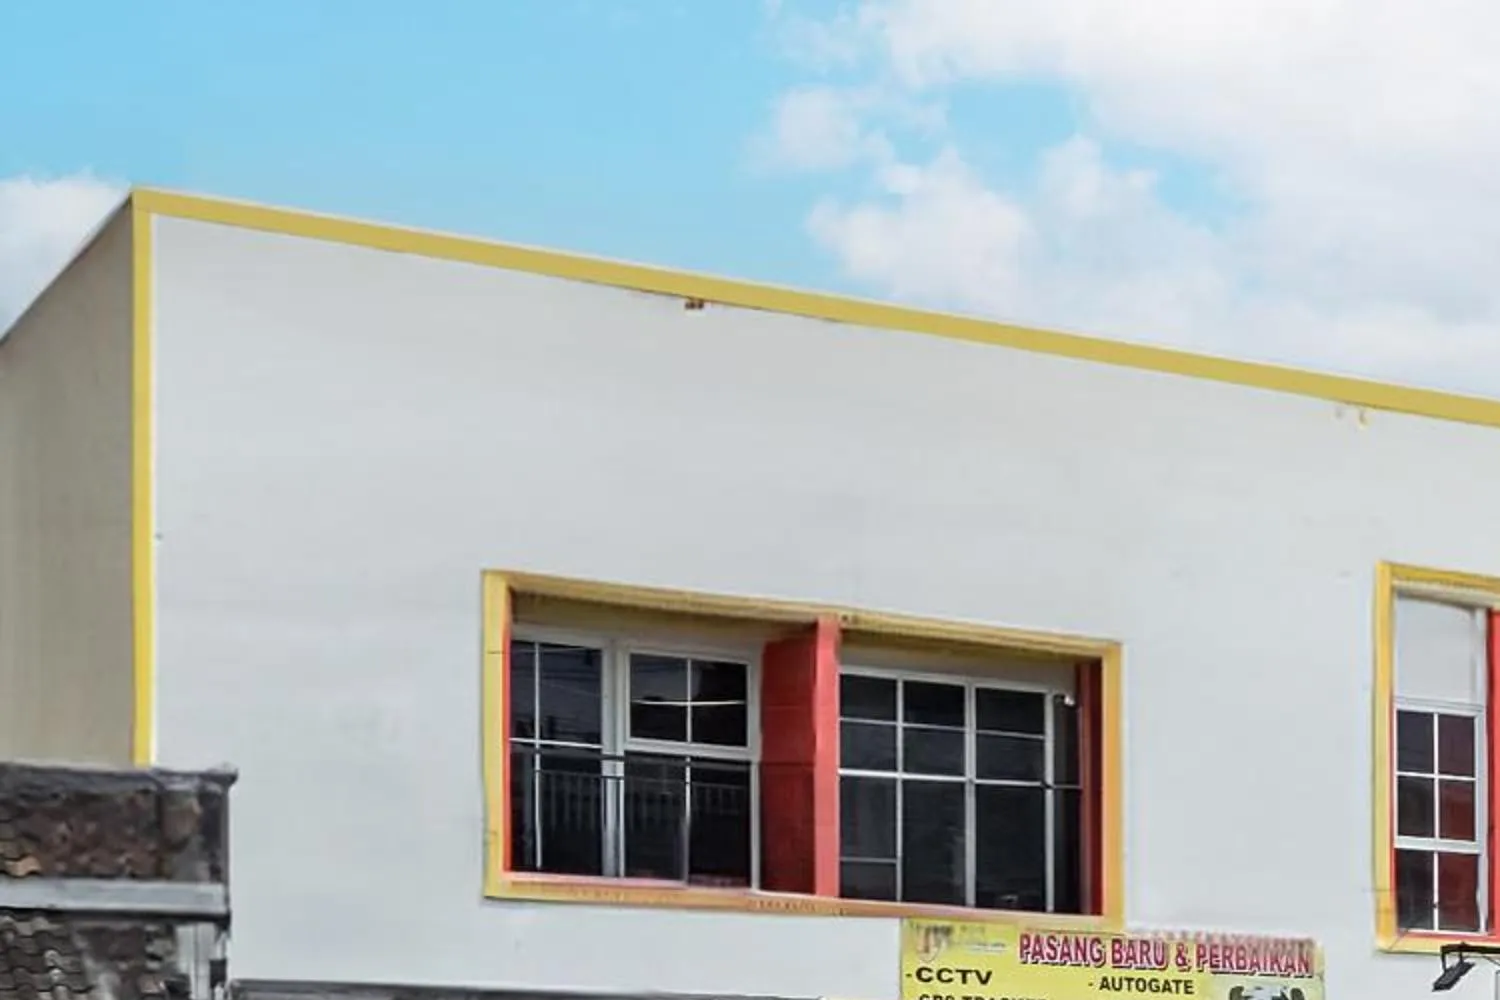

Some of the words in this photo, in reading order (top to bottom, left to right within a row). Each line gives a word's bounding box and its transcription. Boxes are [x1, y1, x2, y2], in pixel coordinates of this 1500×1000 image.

[1018, 932, 1107, 968] PASANG
[1109, 937, 1170, 971] BARU
[1174, 941, 1190, 972] &
[1195, 942, 1314, 978] PERBAIKAN
[915, 966, 993, 985] CCTV
[1099, 976, 1195, 995] AUTOGATE
